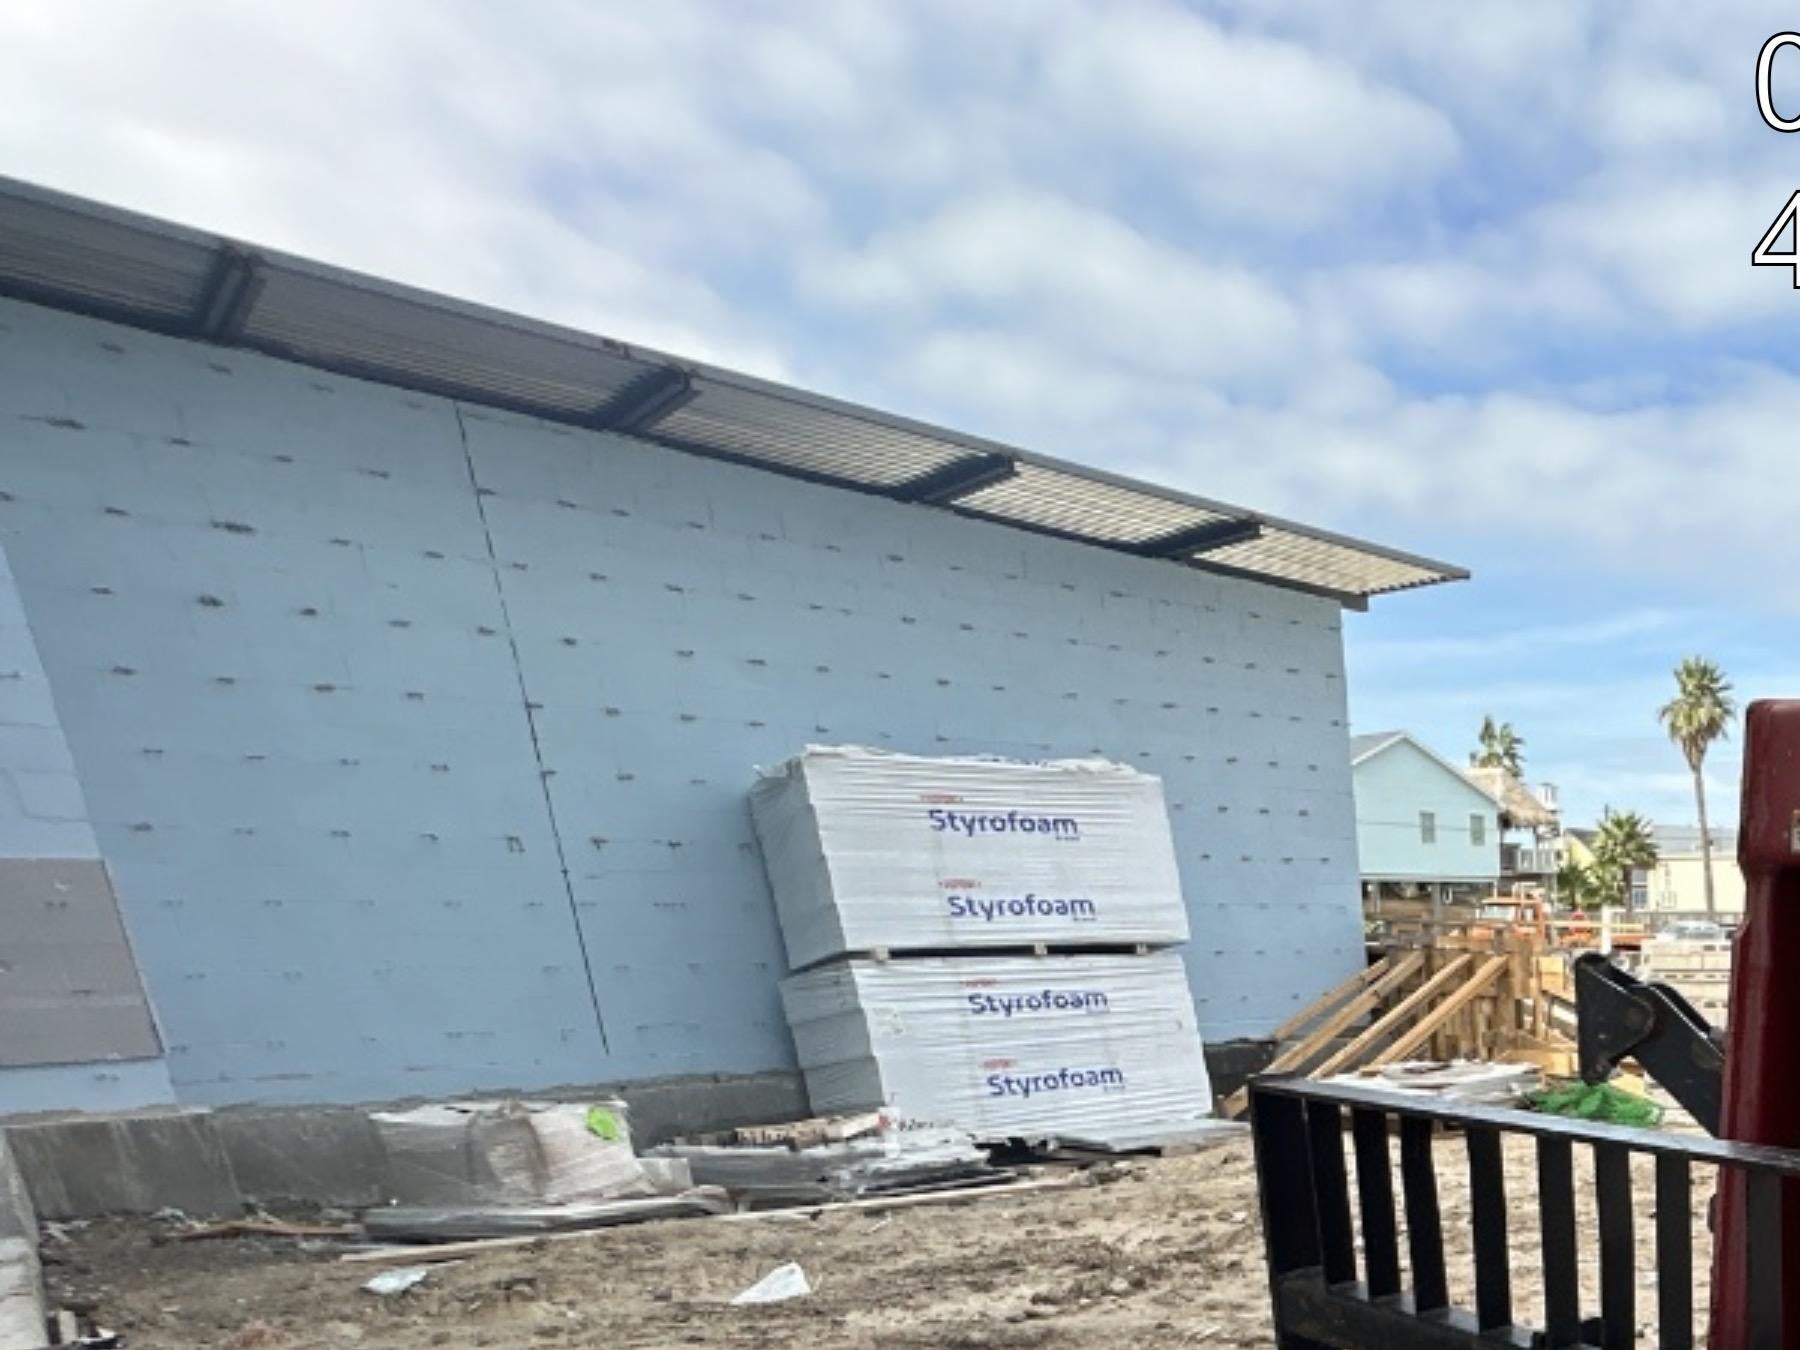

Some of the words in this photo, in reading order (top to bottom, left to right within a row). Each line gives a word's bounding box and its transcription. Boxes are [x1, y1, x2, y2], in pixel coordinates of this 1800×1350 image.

[928, 809, 1079, 837] Styrofoam
[947, 894, 1096, 922] Styrofoam
[967, 989, 1108, 1017] Styrofoam
[986, 1067, 1123, 1098] Styrofoam
